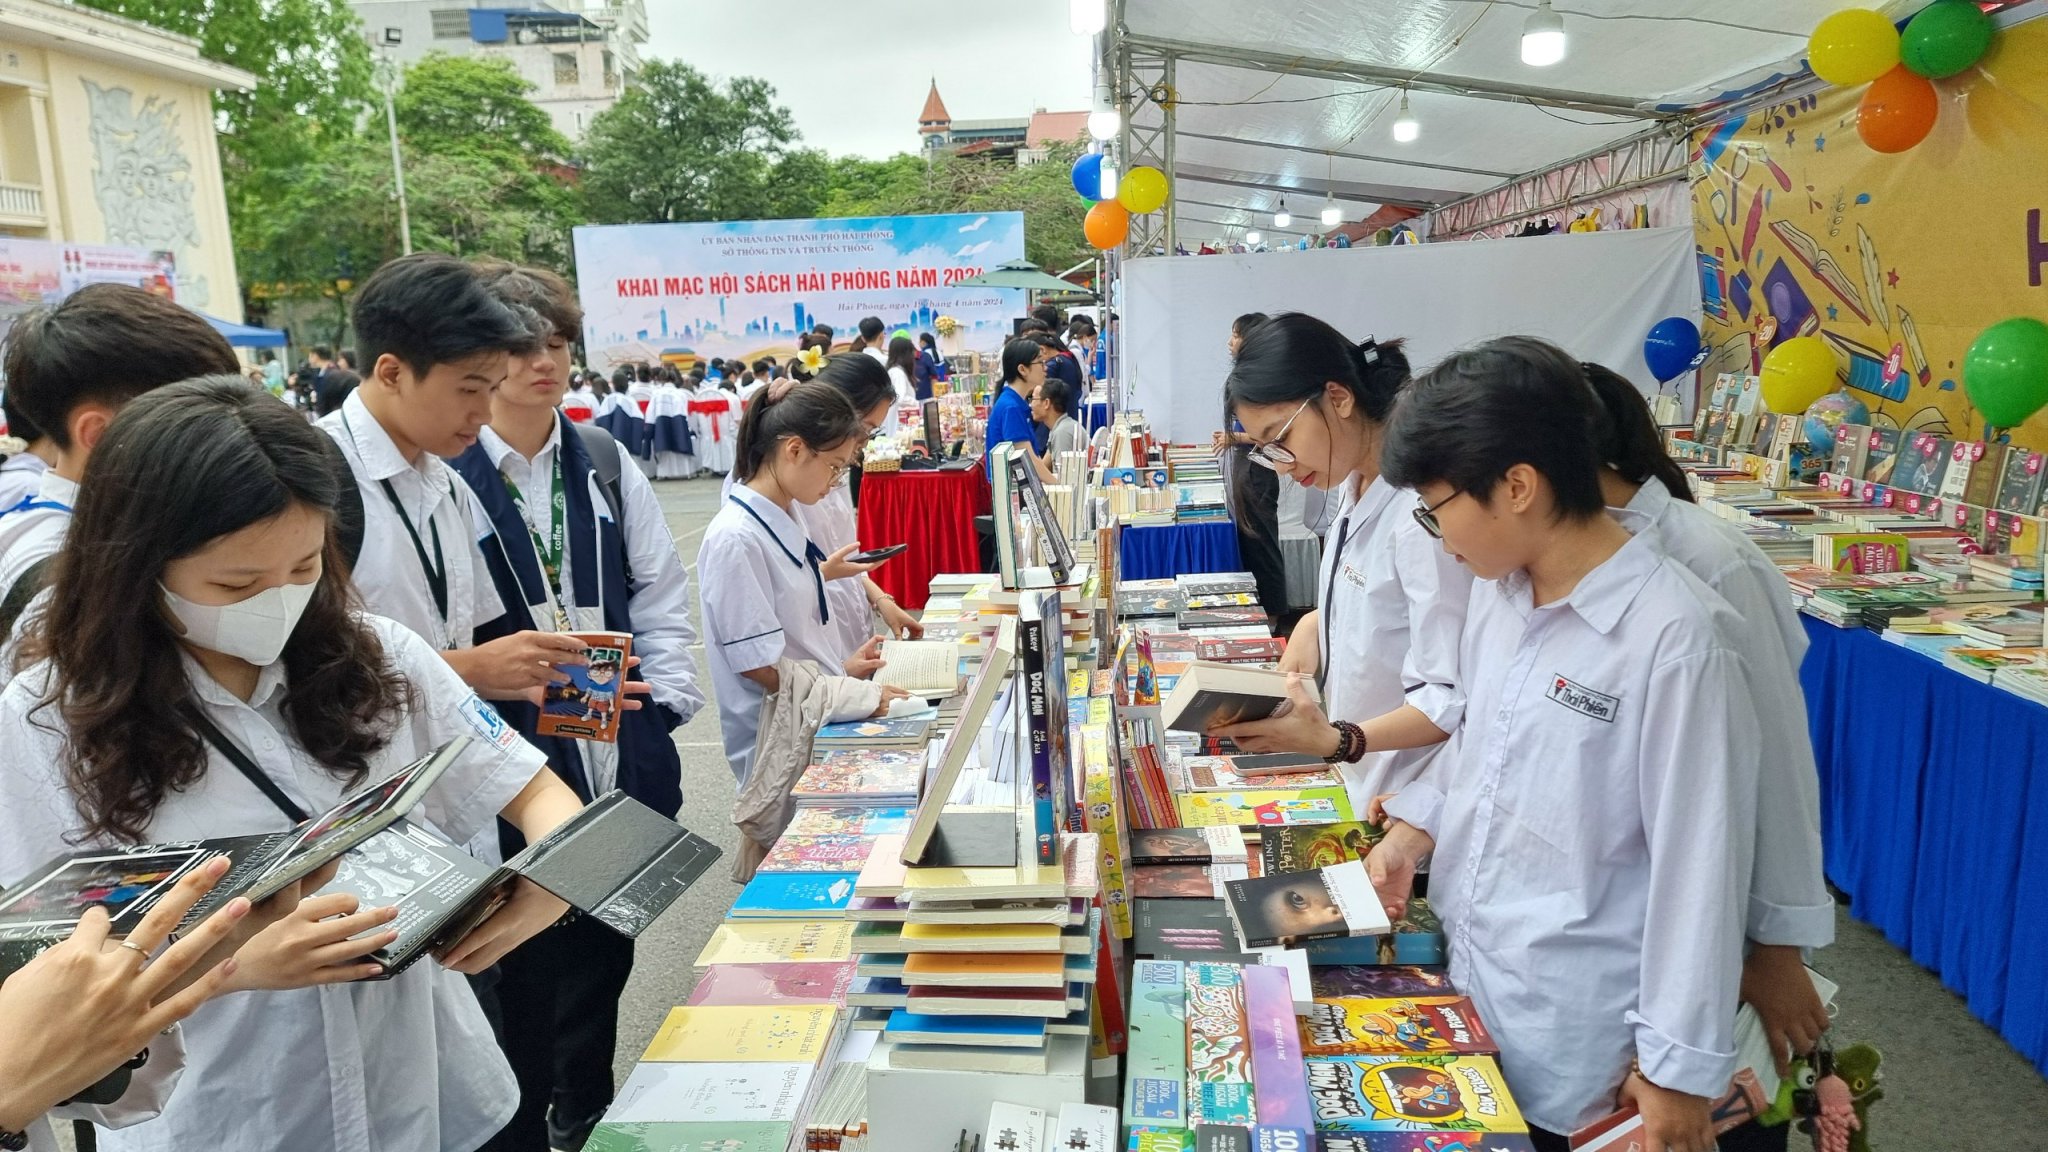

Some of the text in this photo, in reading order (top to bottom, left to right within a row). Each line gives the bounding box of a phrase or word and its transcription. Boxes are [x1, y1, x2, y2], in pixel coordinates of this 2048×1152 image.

[716, 236, 735, 244] BAN
[737, 234, 762, 243] NHÂN
[737, 247, 768, 256] THÔNG
[772, 247, 787, 255] TIN
[788, 245, 802, 254] VÀ
[842, 243, 873, 253] THÔNG
[617, 266, 984, 299] KHAI MẠC HỘI SÁCH HẢI PHÒNG NĂM 202
[1801, 458, 1820, 470] 365
[553, 523, 562, 550] coffee
[1030, 672, 1044, 716] DOG MAN
[1562, 686, 1580, 711] Thái
[1580, 694, 1608, 718] Phiên
[1278, 826, 1294, 870] POTTER
[1142, 964, 1153, 984] PIECES
[1152, 964, 1176, 984] 300
[1210, 966, 1233, 986] 300
[1312, 1022, 1344, 1046] DOG
[1452, 1028, 1471, 1044] DAV
[1160, 1080, 1170, 1100] BOOK
[1203, 1082, 1214, 1098] TREE
[1306, 1062, 1352, 1120] DOG MAN
[1457, 1066, 1493, 1096] PILKEY
[1146, 1080, 1158, 1104] JIGSAW
[1215, 1083, 1226, 1107] JIGSAW
[1228, 1084, 1239, 1103] BOOK
[1203, 1104, 1214, 1118] LIFE
[1476, 1093, 1498, 1116] DAV
